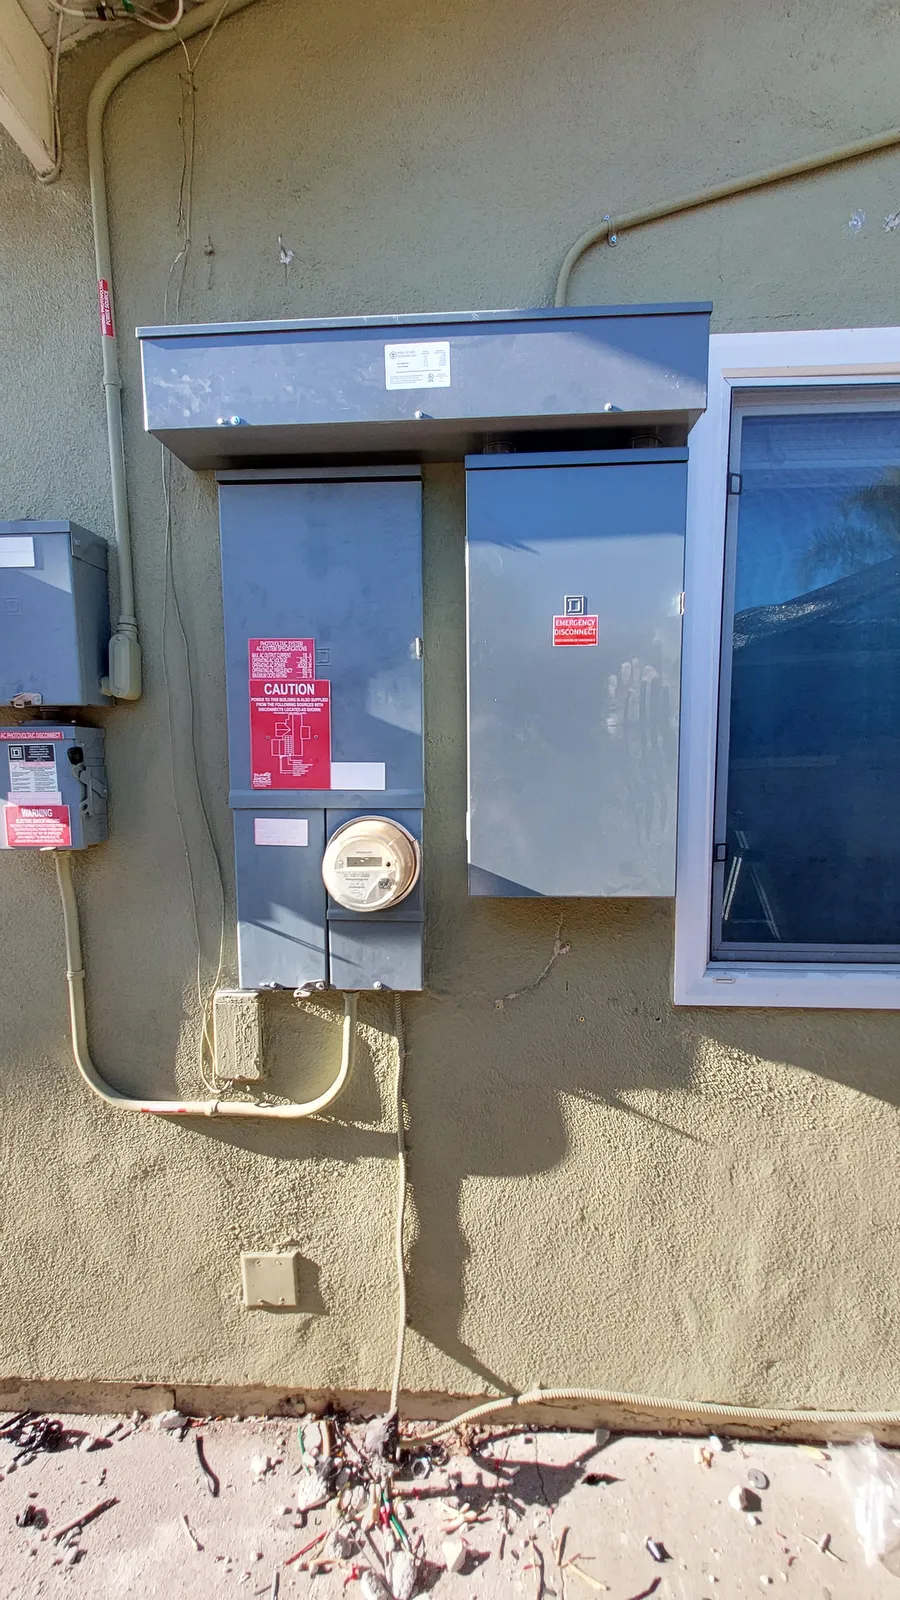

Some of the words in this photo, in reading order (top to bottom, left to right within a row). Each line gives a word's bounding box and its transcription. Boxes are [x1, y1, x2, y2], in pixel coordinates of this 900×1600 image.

[555, 619, 596, 627] EMERGENCY
[554, 628, 597, 636] DISCONNECT
[264, 683, 315, 695] CAUTION
[21, 808, 53, 818] WARNING
